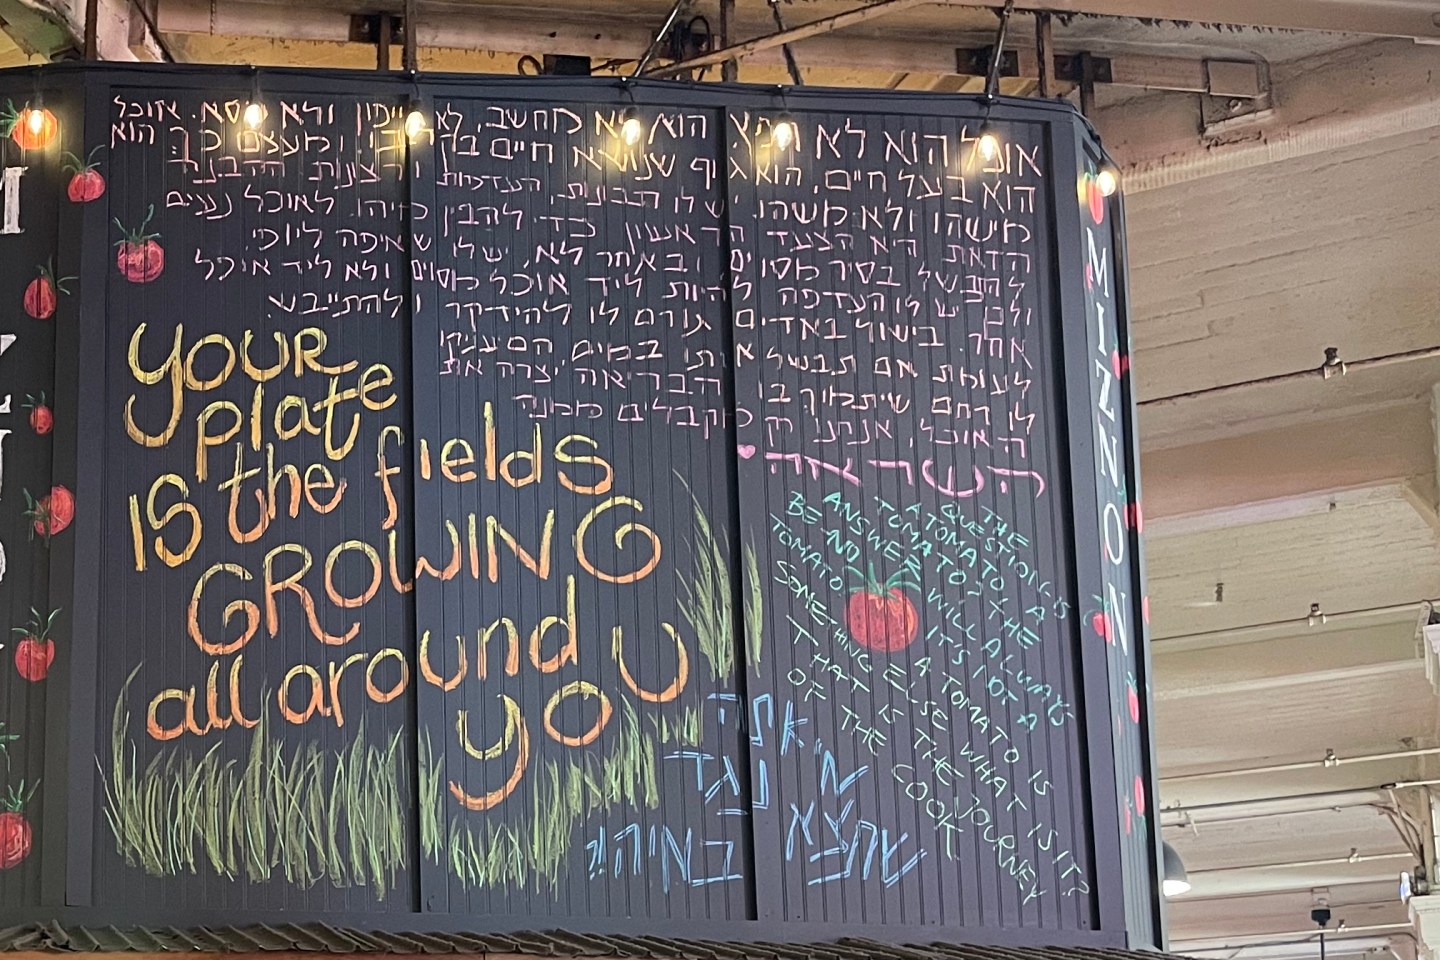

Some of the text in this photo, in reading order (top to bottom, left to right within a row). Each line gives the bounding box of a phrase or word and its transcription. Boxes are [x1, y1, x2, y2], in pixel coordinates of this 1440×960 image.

[755, 165, 802, 186] הוא
[817, 118, 949, 167] הוא לא
[861, 199, 913, 232] ולא
[898, 169, 973, 203] בעל
[983, 180, 1035, 213] הוא
[344, 254, 389, 281] ולא
[195, 362, 398, 483] plate
[1087, 227, 1131, 657] MIZNON
[129, 401, 615, 572] IS the fields
[786, 491, 823, 524] BE
[188, 496, 662, 655] GROWING
[823, 492, 921, 581] ANSWER
[926, 513, 1004, 591] TOMATO
[147, 576, 579, 742] all around
[787, 668, 826, 702] OF
[942, 672, 1054, 795] TOMATO IS
[960, 742, 1027, 811] WHAT
[1028, 823, 1058, 851] IS
